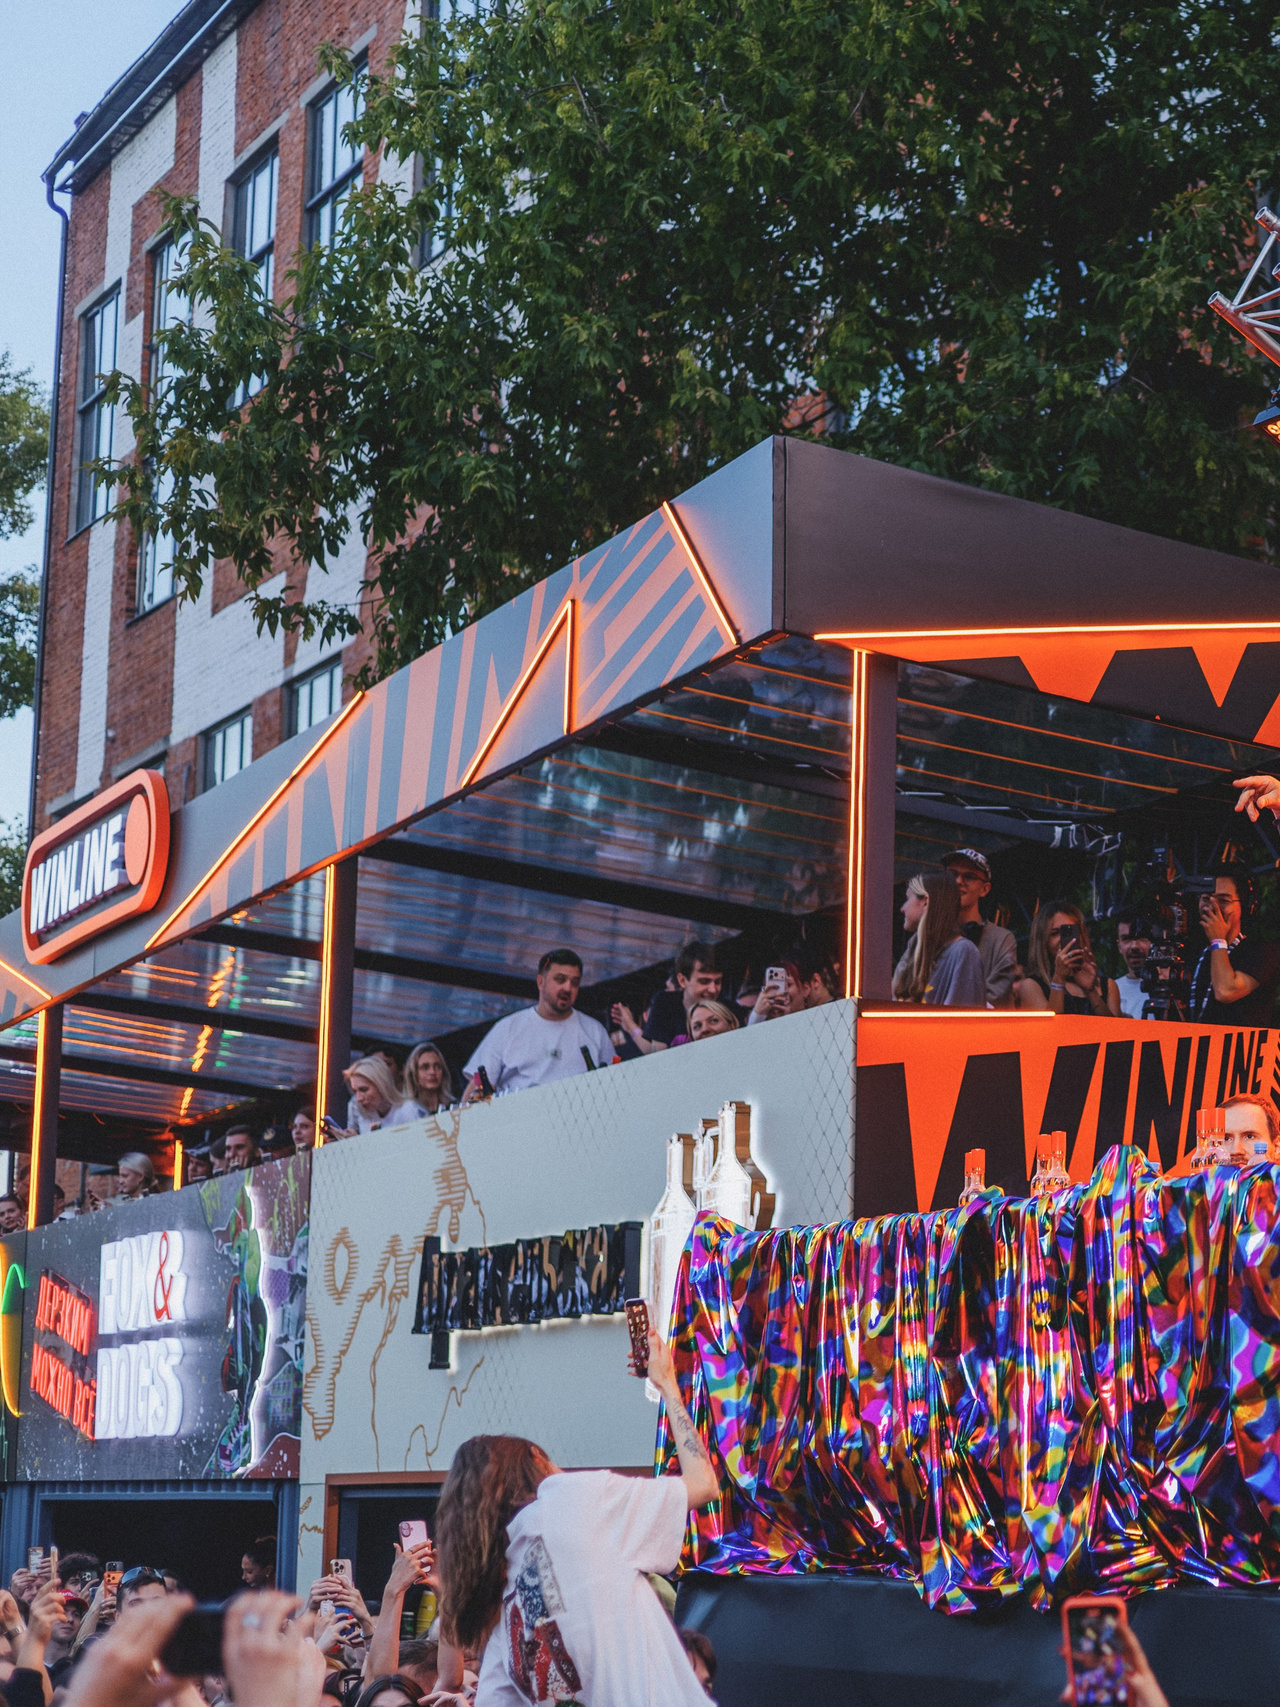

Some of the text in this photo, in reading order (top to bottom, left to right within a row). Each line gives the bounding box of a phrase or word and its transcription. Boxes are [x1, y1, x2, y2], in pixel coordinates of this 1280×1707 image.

[30, 813, 123, 936] WINLINE
[35, 1275, 93, 1357] ДЕРЗКИМ
[99, 1233, 158, 1334] FOX
[30, 1342, 75, 1419] МОЖНО
[95, 1338, 183, 1439] DOGS
